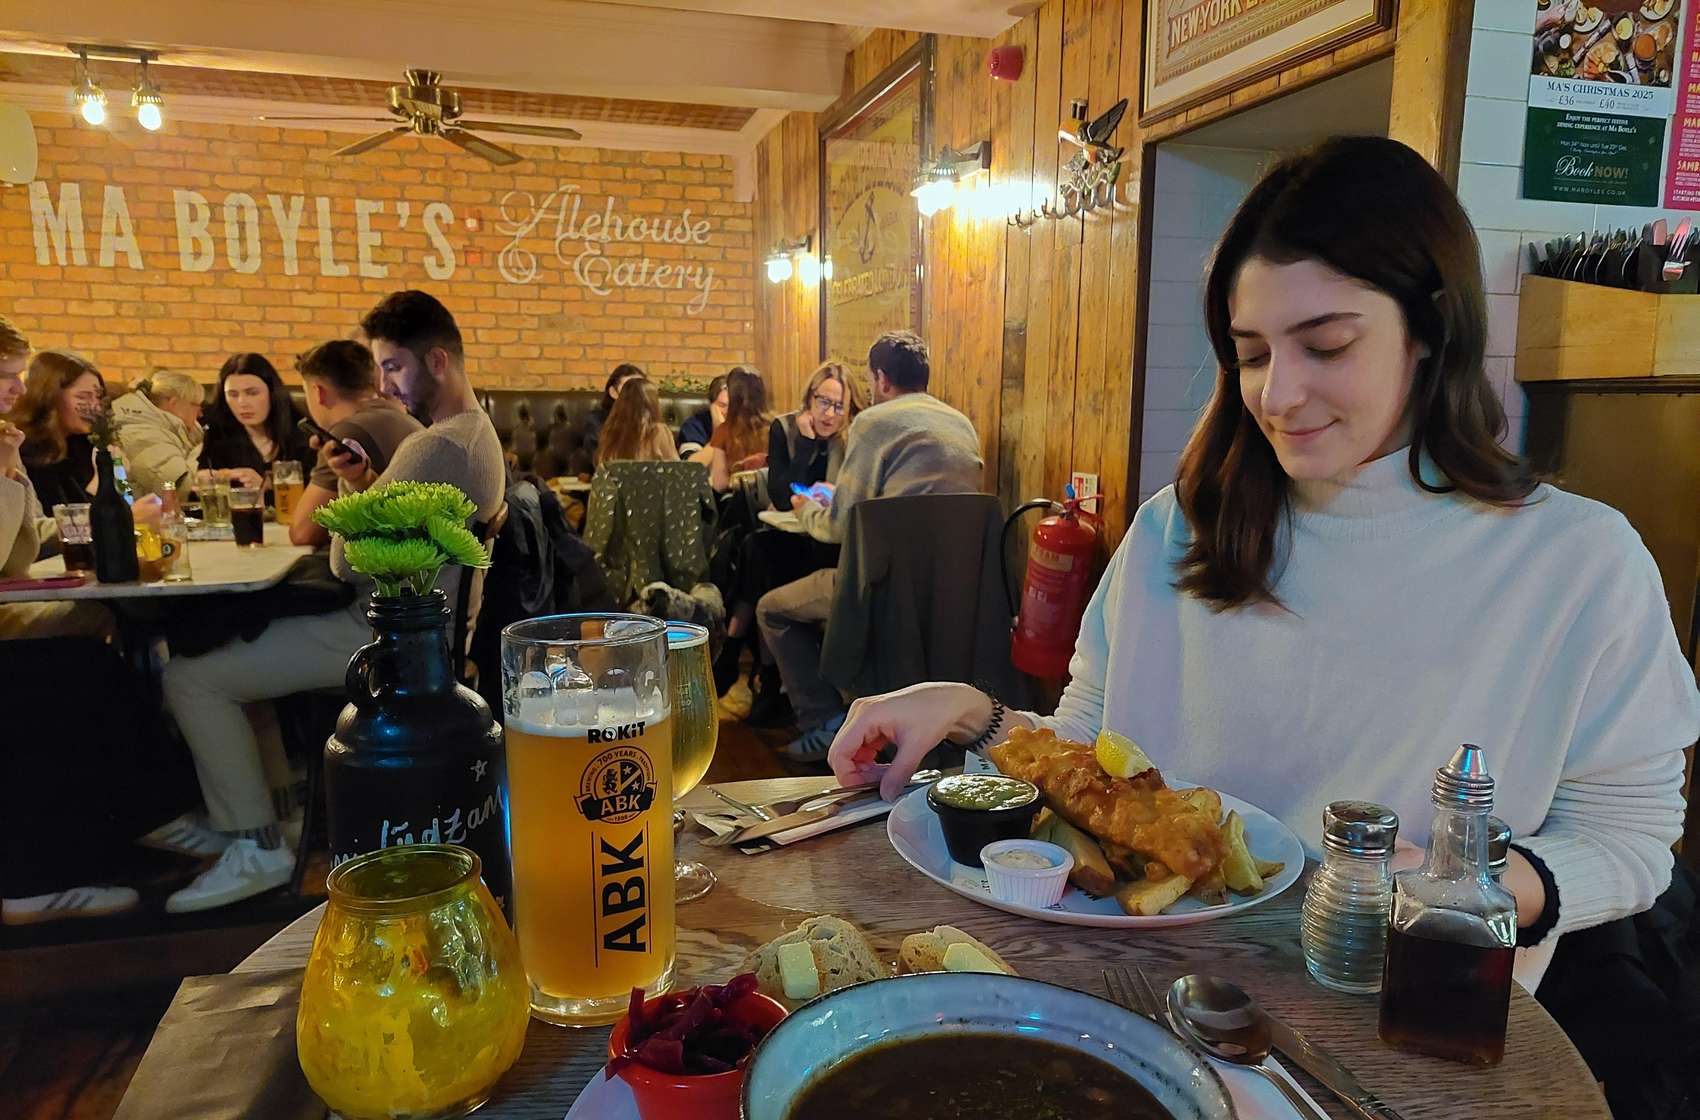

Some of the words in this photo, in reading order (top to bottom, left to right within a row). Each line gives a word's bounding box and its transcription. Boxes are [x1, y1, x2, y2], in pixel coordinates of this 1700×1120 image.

[1547, 81, 1570, 91] MA'S
[1572, 83, 1630, 98] CHRISTMAS
[1632, 90, 1654, 99] 2025
[1558, 95, 1574, 105] £36
[1599, 98, 1615, 109] £40
[1554, 155, 1594, 177] Book
[1594, 166, 1629, 179] NOW!
[496, 184, 712, 244] Alehouse
[28, 181, 144, 270] MA
[173, 189, 456, 280] BOYLE'S
[557, 235, 716, 315] Eatery
[588, 721, 646, 744] ROKiT
[597, 753, 613, 766] 700
[614, 750, 637, 759] YEARS
[600, 794, 641, 815] ABK
[600, 829, 646, 952] ABK
